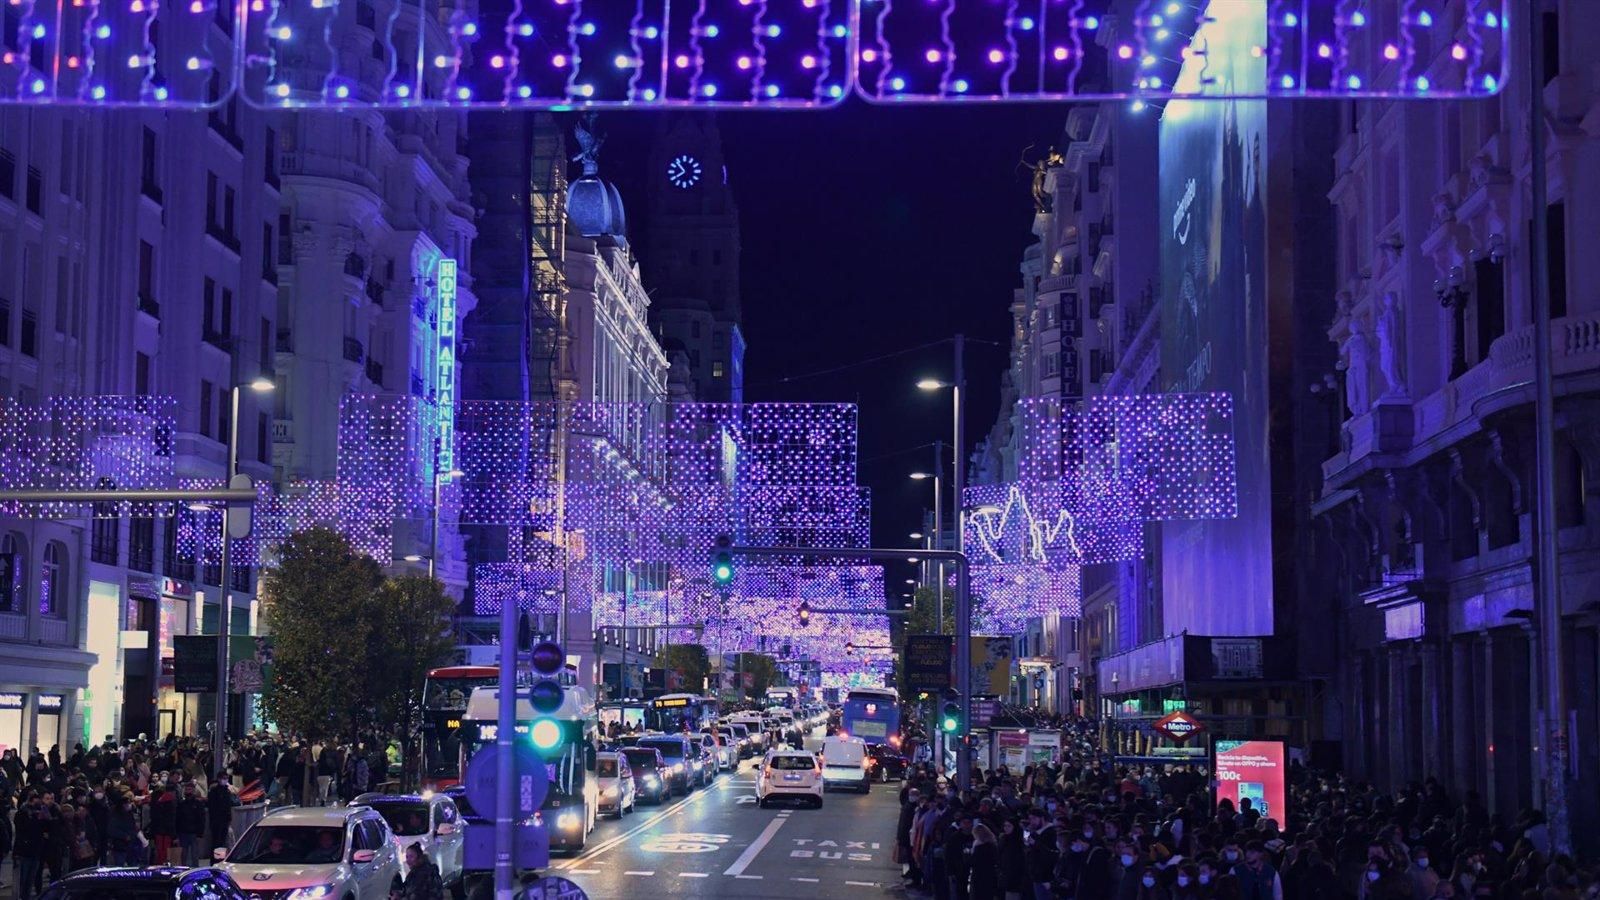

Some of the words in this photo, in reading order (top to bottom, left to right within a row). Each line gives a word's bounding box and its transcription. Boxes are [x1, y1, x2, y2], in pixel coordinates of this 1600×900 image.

[441, 262, 454, 337] HOTEL
[1062, 319, 1075, 394] HOTEL
[1167, 723, 1191, 731] Metro
[791, 839, 880, 849] TAXI
[790, 850, 872, 861] BUS
